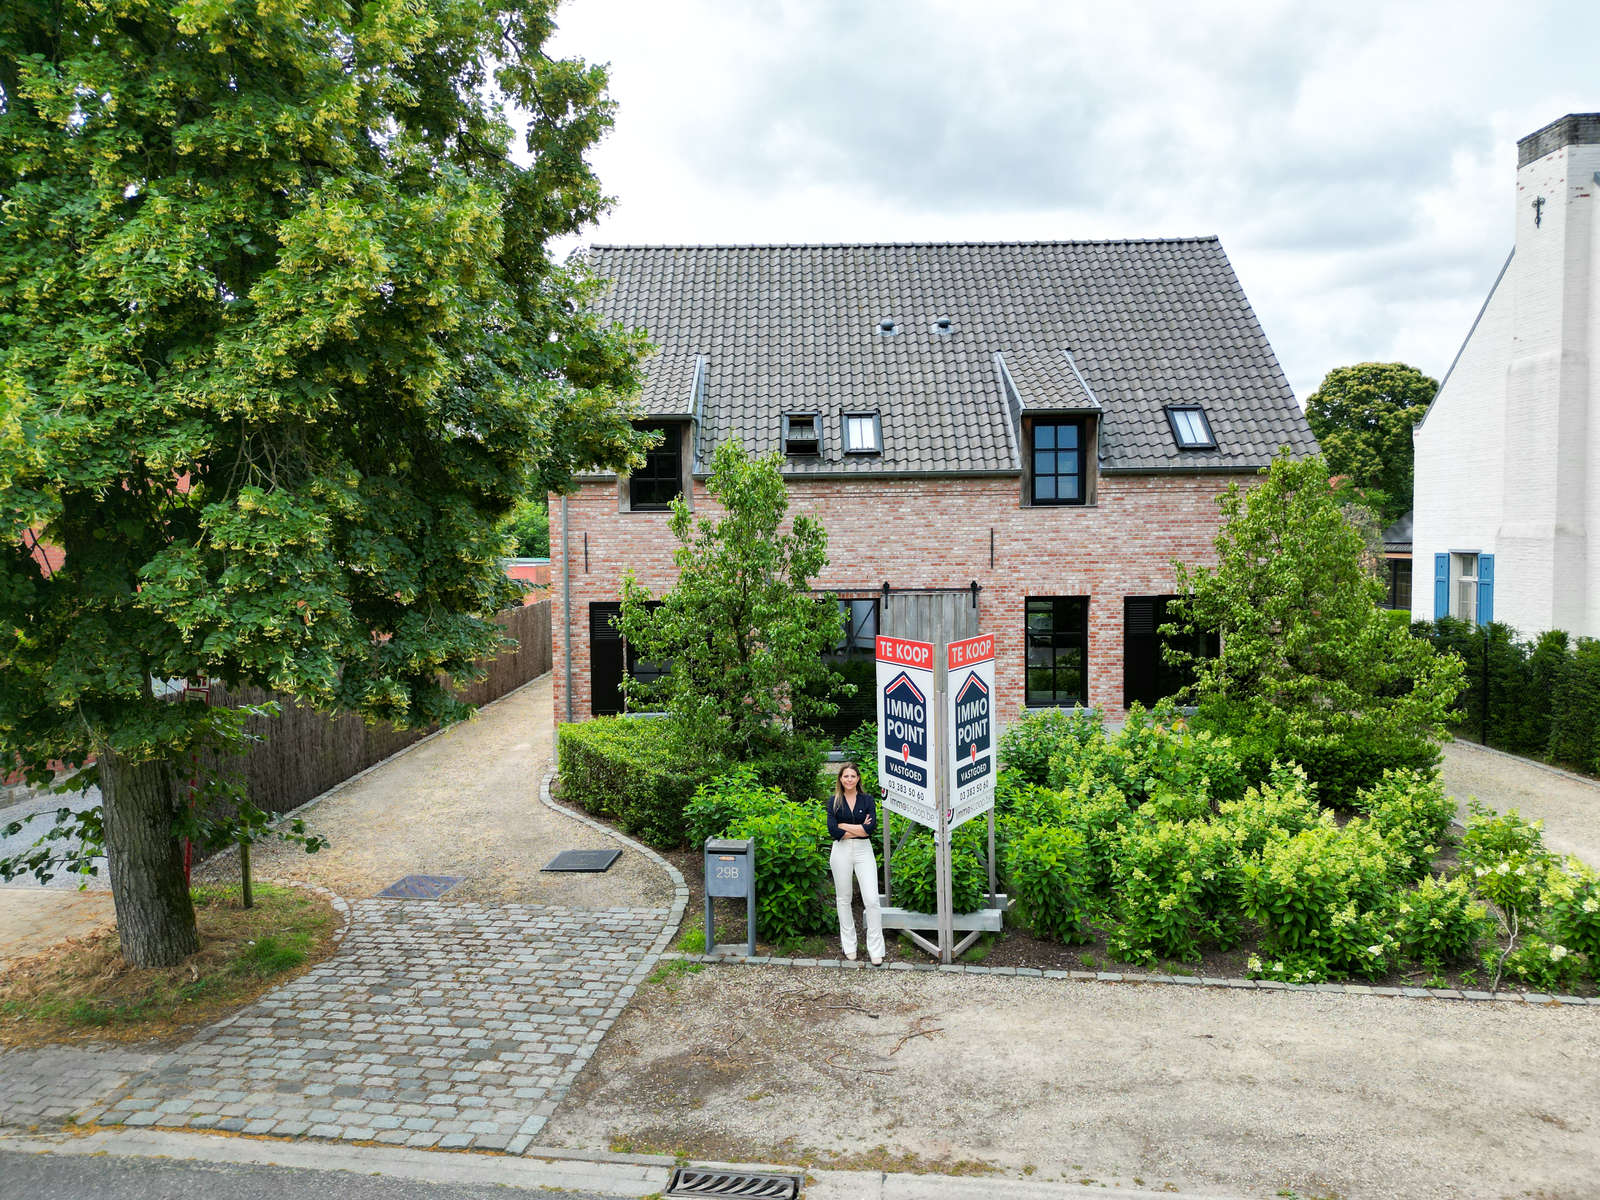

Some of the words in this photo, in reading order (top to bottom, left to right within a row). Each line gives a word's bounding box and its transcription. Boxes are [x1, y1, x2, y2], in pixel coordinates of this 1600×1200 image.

[880, 641, 892, 657] TE
[897, 644, 928, 663] KOOP
[952, 646, 963, 662] TE
[966, 640, 991, 659] KOOP
[887, 698, 924, 723] IMMO
[957, 698, 987, 724] IMMO
[887, 719, 924, 745] POINT
[958, 719, 987, 745] POINT
[890, 762, 922, 782] VASTGOED
[960, 763, 987, 782] VASTGOED
[888, 779, 896, 789] 03
[897, 782, 907, 794] 383
[908, 787, 916, 798] 50
[916, 791, 925, 801] 60
[959, 791, 966, 801] 03
[716, 866, 739, 879] 29B
